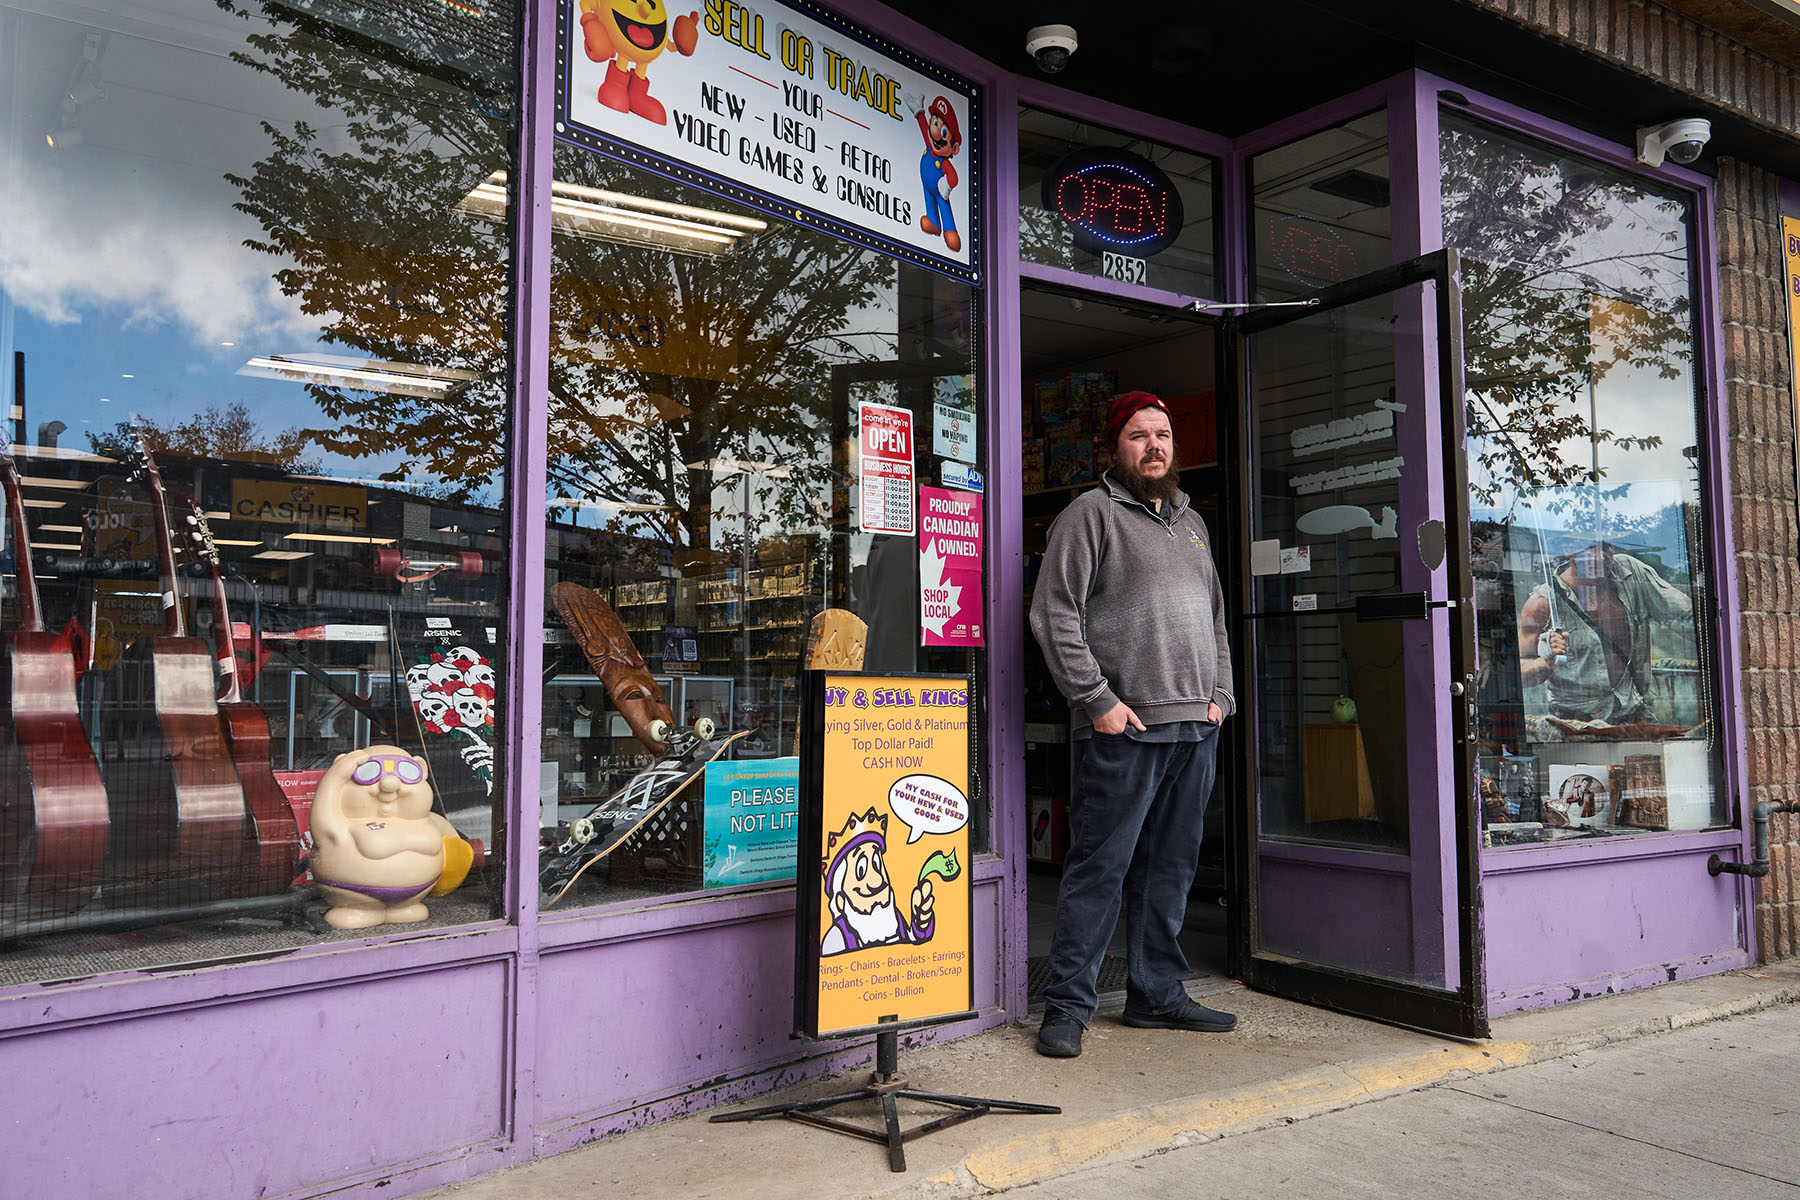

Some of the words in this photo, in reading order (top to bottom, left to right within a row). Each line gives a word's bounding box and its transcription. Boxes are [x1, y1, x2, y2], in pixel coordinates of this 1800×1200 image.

[704, 0, 771, 60] SELL
[781, 28, 814, 80] OR
[823, 47, 904, 122] TRADE
[782, 79, 824, 121] YOUR
[701, 81, 746, 123] NEW
[773, 112, 816, 154] USED
[841, 141, 892, 184] RETRO
[673, 109, 731, 156] VIDEO
[739, 136, 804, 185] GAMES
[812, 165, 829, 194] &
[836, 175, 912, 226] CONSOLES
[1057, 174, 1167, 237] OPEN
[1104, 253, 1146, 286] 2852
[864, 415, 884, 424] come
[885, 415, 891, 424] in
[939, 406, 947, 417] NO
[947, 409, 971, 423] SMOKING
[869, 427, 906, 455] OPEN
[941, 428, 949, 440] NO
[949, 431, 969, 443] VAPING
[893, 463, 911, 475] HOURS
[943, 473, 960, 482] secured
[236, 498, 361, 523] CASHIER
[930, 497, 971, 517] PROUDLY
[923, 515, 979, 538] CANADIAN
[938, 538, 979, 557] OWNED.
[924, 588, 949, 603] SHOP
[924, 604, 952, 619] LOCAL
[423, 629, 463, 637] ARSENIC
[852, 687, 870, 710] &
[872, 687, 916, 708] SELL
[919, 688, 968, 708] KINGS
[853, 718, 885, 733] Silver,
[886, 718, 912, 731] Gold
[914, 719, 922, 731] &
[924, 718, 968, 731] Platinum
[852, 738, 872, 752] Top
[875, 737, 906, 750] Dollar
[908, 737, 934, 750] Paid!
[863, 756, 893, 769] CA$H
[895, 756, 923, 769] NOW
[731, 786, 795, 808] PLEASE
[895, 788, 916, 803] YOUR
[917, 797, 936, 810] NEW
[936, 805, 943, 814] &
[944, 807, 965, 821] USED
[905, 782, 919, 793] MY
[920, 788, 942, 802] CASH
[942, 796, 959, 809] FOR
[731, 813, 767, 834] NOT
[914, 807, 941, 822] GOODS
[850, 959, 880, 972] Chains
[887, 954, 926, 967] Bracelets
[932, 950, 966, 962] Earrings
[821, 978, 864, 991] Pendants
[870, 971, 900, 985] Dental
[906, 965, 963, 980] Broken/Scrap
[862, 990, 888, 1001] Coins
[894, 985, 925, 998] Bullion
